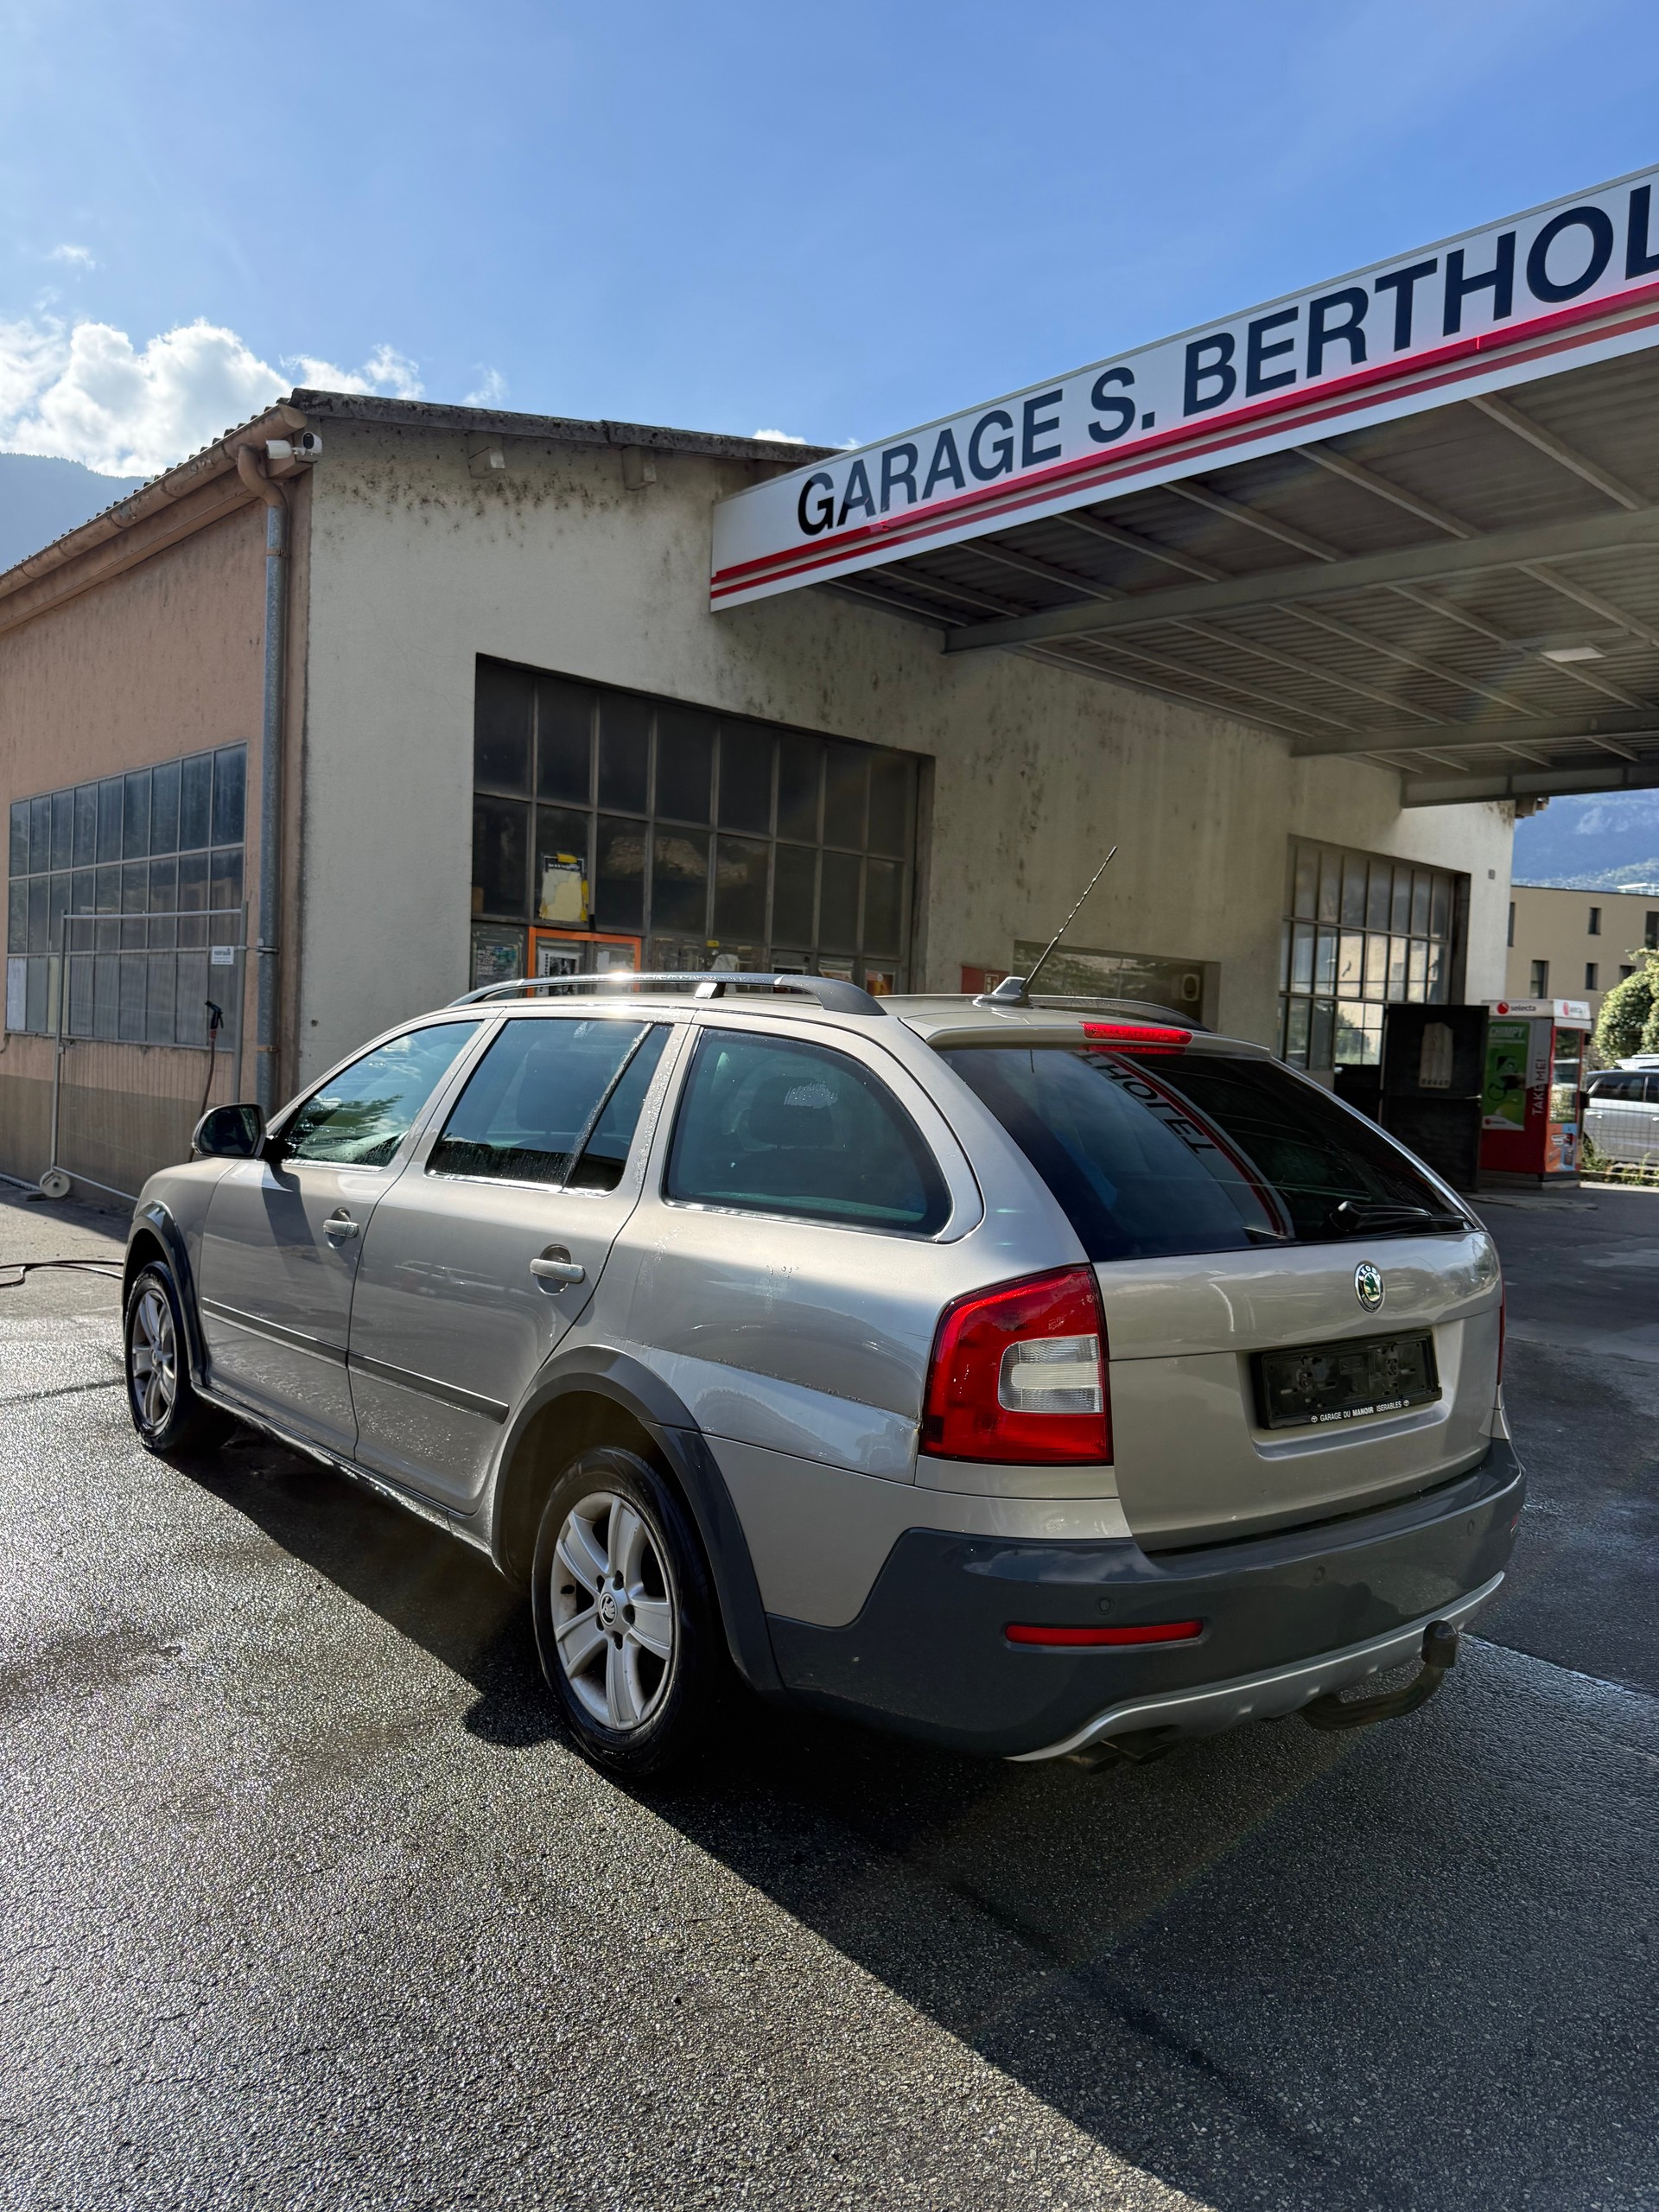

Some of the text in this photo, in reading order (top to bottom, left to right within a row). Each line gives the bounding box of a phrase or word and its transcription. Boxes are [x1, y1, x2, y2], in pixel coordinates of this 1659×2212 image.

[798, 184, 1659, 536] GARAGE S. BERTHOL
[1533, 1084, 1545, 1115] TAKE
[1320, 1412, 1341, 1421] GARAGE
[1352, 1407, 1374, 1417] MANOIR
[1376, 1401, 1402, 1412] ISERABLES
